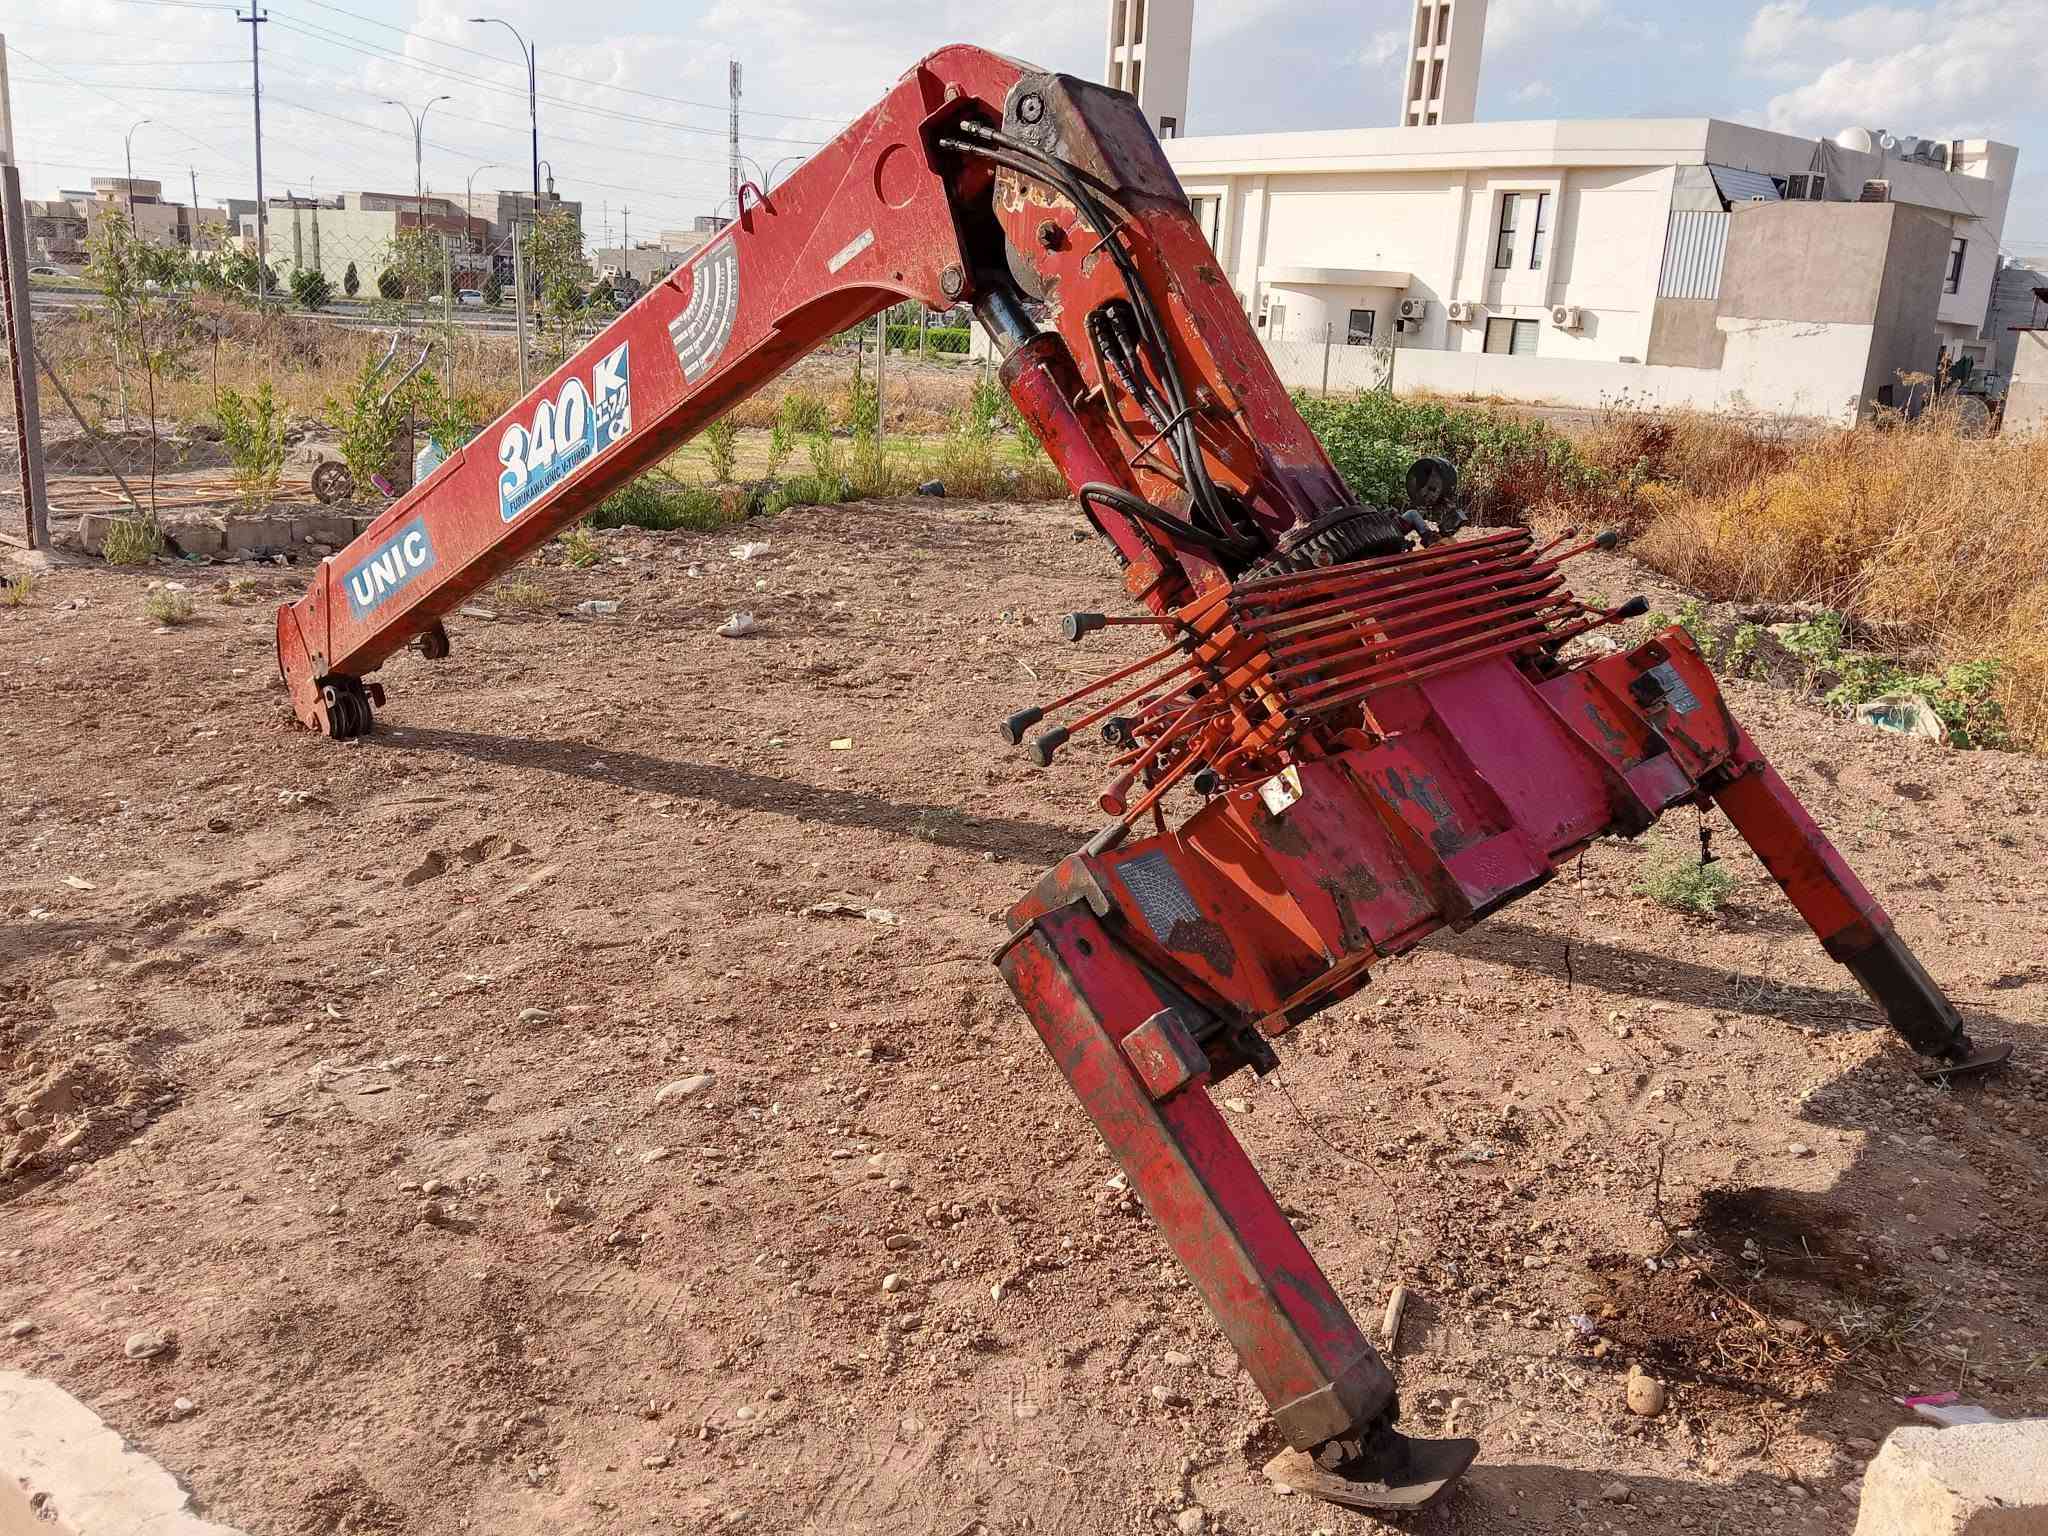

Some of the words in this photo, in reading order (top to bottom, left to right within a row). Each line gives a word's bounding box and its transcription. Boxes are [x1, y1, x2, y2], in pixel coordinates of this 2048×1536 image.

[499, 378, 588, 496] 340
[509, 480, 544, 513] FURUKAWA
[544, 466, 561, 486] UNIC
[351, 531, 426, 606] UNIC
